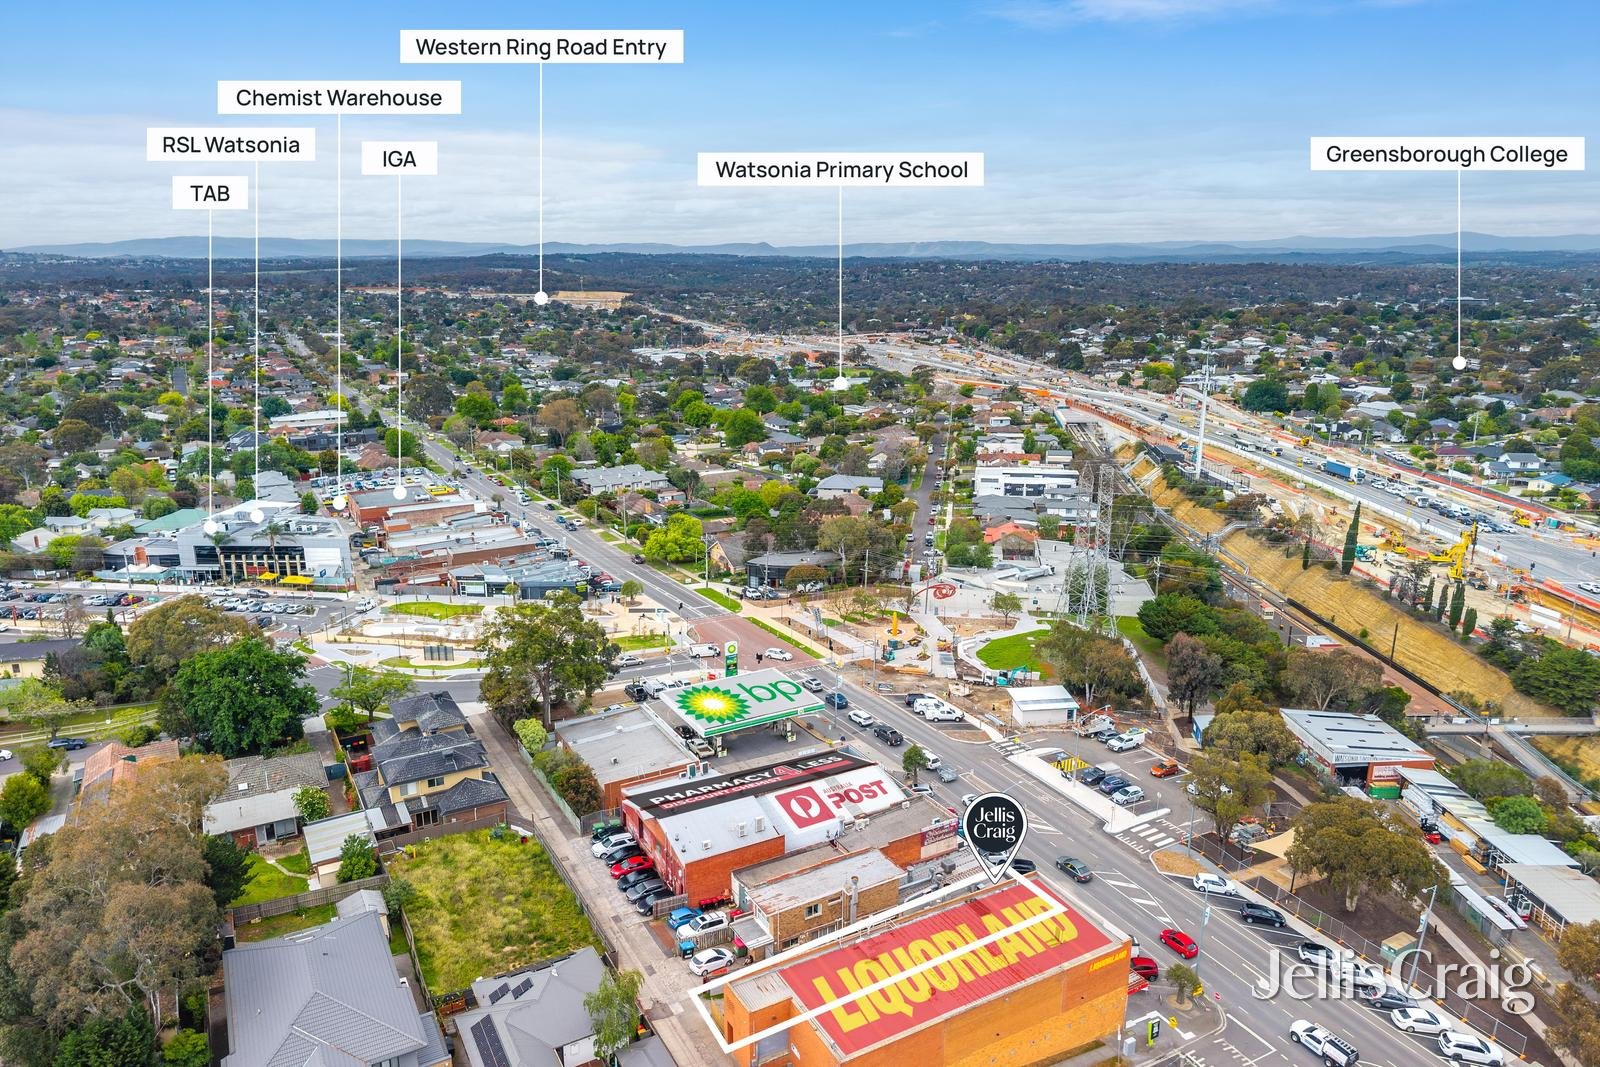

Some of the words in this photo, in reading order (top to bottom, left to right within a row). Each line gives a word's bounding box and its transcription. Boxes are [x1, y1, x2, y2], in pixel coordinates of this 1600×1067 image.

[736, 679, 803, 703] bp
[648, 771, 773, 805] PHARMACY
[772, 764, 799, 776] 4
[797, 755, 843, 771] LESS
[662, 789, 731, 810] DISCOUNT
[732, 776, 786, 792] CHEMIST
[826, 779, 889, 809] POST
[812, 895, 1079, 1034] LIQUORLAND
